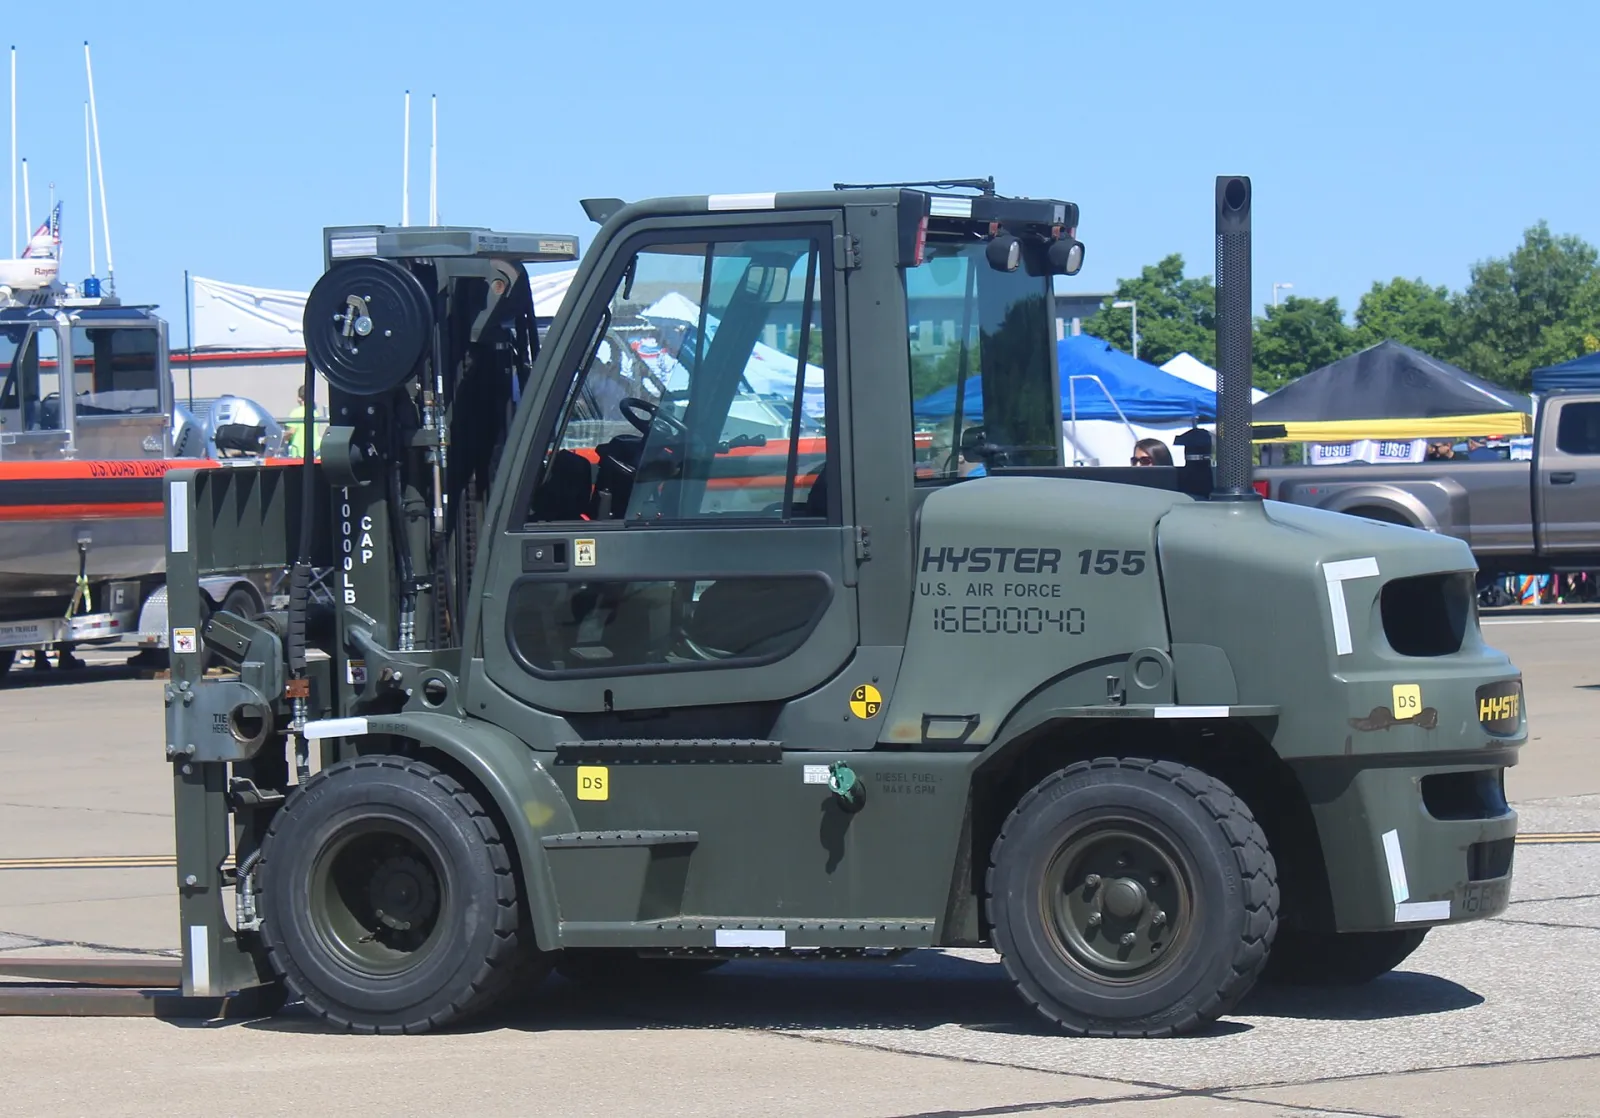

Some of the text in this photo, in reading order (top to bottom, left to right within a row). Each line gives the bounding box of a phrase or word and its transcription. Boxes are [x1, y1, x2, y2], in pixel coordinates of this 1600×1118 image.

[1324, 445, 1347, 457] USO
[1383, 442, 1407, 458] USO
[105, 461, 140, 477] COAST
[360, 515, 374, 564] CAP
[920, 546, 1147, 576] HYSTER 155
[919, 583, 1062, 598] U.S. AIR FORCE
[933, 606, 1086, 636] 16E00040
[856, 689, 876, 714] C G
[1397, 695, 1417, 708] DS
[212, 713, 228, 723] TIE
[582, 776, 603, 790] DS
[875, 772, 908, 782] DIESEL
[912, 772, 938, 783] FUEL
[882, 784, 903, 794] MAX
[914, 784, 936, 795] GPM
